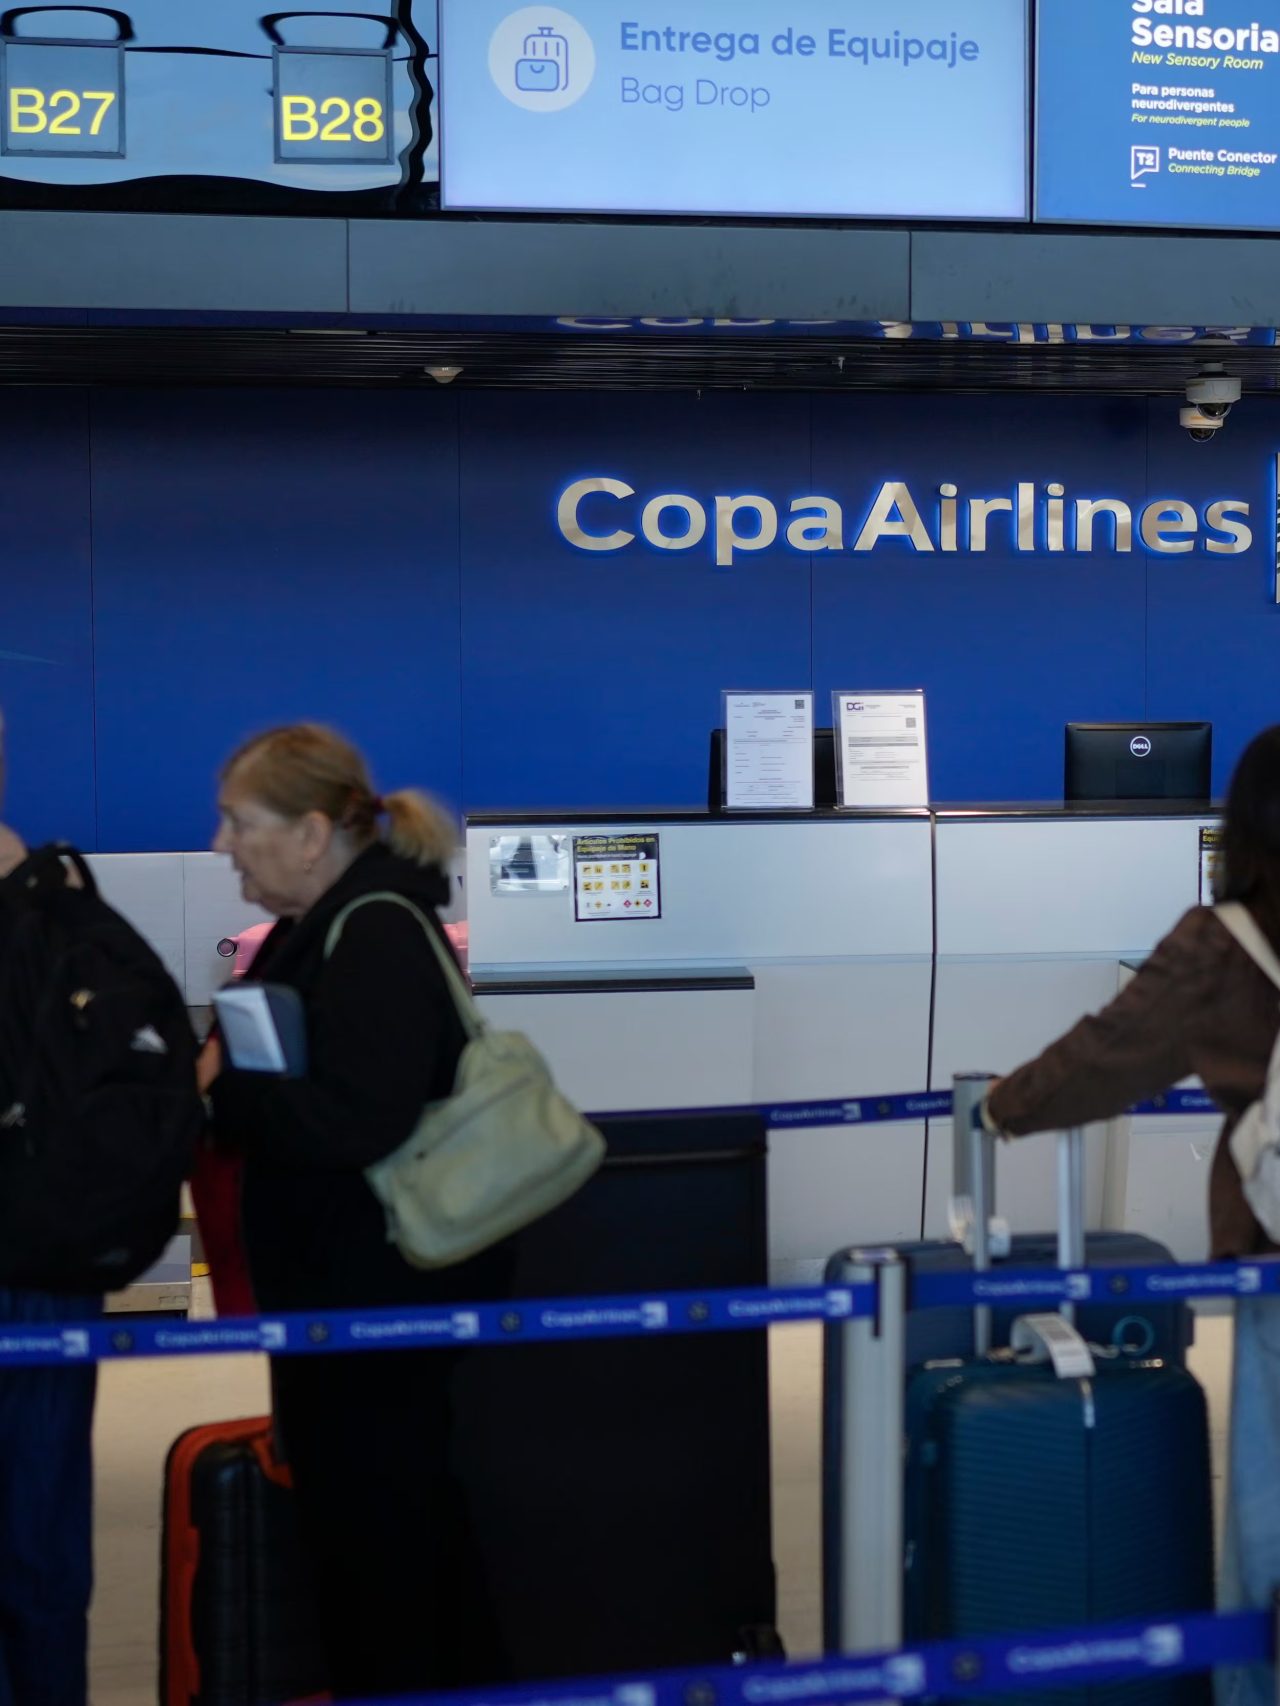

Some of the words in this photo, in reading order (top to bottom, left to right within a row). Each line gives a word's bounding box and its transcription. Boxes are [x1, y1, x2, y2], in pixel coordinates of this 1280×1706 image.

[620, 21, 761, 62] Entrega
[771, 27, 817, 57] de
[828, 28, 980, 68] Equipaje
[1131, 51, 1163, 65] New
[1165, 53, 1221, 70] Sensory
[1222, 55, 1264, 70] Room
[620, 77, 684, 112] Bag
[695, 79, 771, 113] Drop
[1131, 83, 1159, 96] Para
[1161, 86, 1215, 99] personas
[9, 87, 116, 137] B27
[1131, 98, 1235, 114] neurodivergentes
[281, 95, 385, 143] B28
[1131, 113, 1148, 124] For
[1148, 114, 1218, 128] neurodivergent
[1218, 118, 1251, 129] people
[1136, 152, 1155, 166] T2
[1168, 147, 1214, 162] Puente
[1217, 149, 1278, 164] Conector
[1168, 162, 1225, 177] Connecting
[1226, 165, 1261, 178] Bridge
[556, 476, 1253, 566] CopaAirlines
